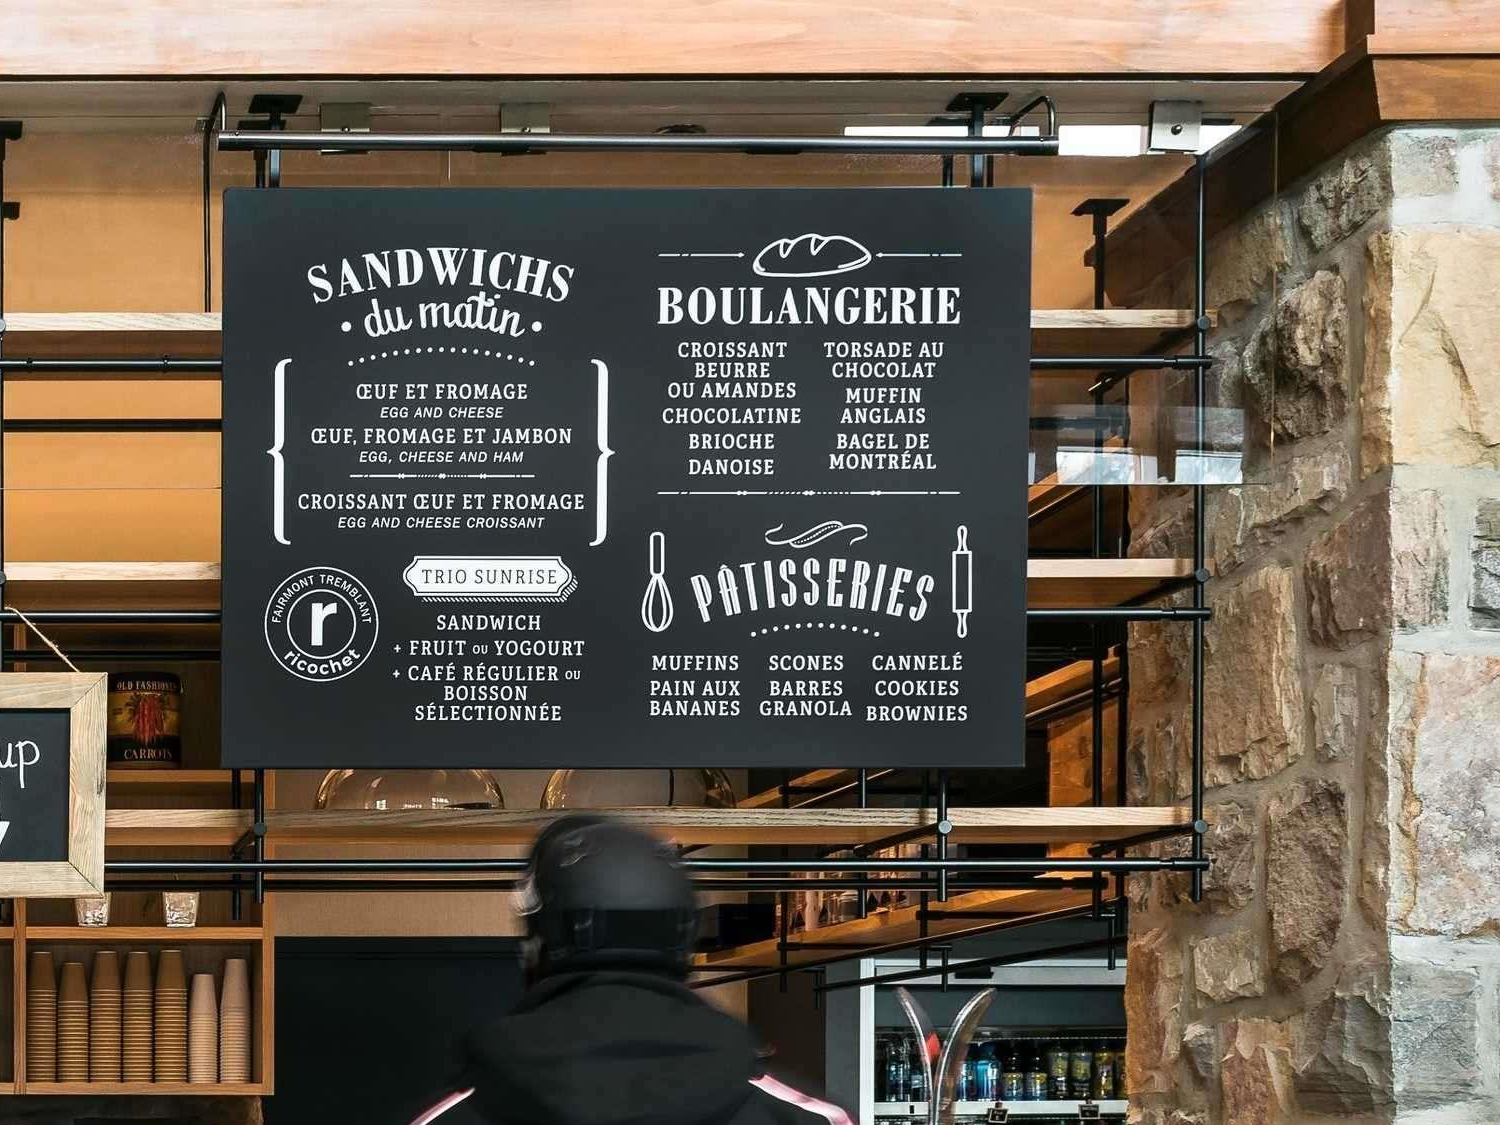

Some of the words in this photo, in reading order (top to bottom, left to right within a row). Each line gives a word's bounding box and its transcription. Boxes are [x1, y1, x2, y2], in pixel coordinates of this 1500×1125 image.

[307, 247, 574, 303] SANDWICHS
[657, 287, 960, 324] BOULANGERIE
[364, 299, 412, 337] du
[419, 291, 525, 337] matin
[678, 342, 787, 357] CROISSANT
[824, 342, 912, 357] TORSADE
[919, 342, 944, 357] AU
[695, 362, 770, 378] BEURRE
[832, 362, 936, 378] CHOCOLAT
[356, 384, 398, 399] ŒUF
[406, 384, 428, 399] ET
[436, 384, 527, 399] FROMAGE
[668, 382, 695, 398] OU
[701, 382, 796, 398] AMANDES
[846, 388, 921, 403] MUFFIN
[380, 407, 408, 418] EGG
[414, 407, 442, 418] AND
[449, 407, 503, 418] CHEESE
[663, 408, 801, 424] CHOCOLATINE
[840, 408, 925, 424] ANGLAIS
[311, 428, 356, 445] ŒUF,
[364, 428, 456, 444] FROMAGE
[463, 428, 486, 443] ET
[493, 428, 571, 444] JAMBON
[689, 434, 774, 449] BRIOCHE
[837, 433, 898, 449] BAGEL
[905, 434, 929, 449] DE
[360, 451, 391, 464] EGG,
[399, 451, 454, 462] CHEESE
[459, 452, 487, 462] AND
[494, 452, 523, 462] HAM
[829, 450, 936, 469] MONTRÉAL
[689, 459, 774, 475] DANOISE
[298, 494, 407, 509] CROISSANT
[414, 494, 455, 509] ŒUF
[463, 494, 485, 509] ET
[492, 494, 584, 509] FROMAGE
[338, 517, 366, 528] EGG
[372, 517, 400, 528] AND
[406, 517, 461, 528] CHEESE
[467, 517, 545, 528] CROISSANT
[422, 570, 466, 583] TRIO
[475, 570, 556, 584] SUNRISE
[691, 558, 934, 622] PÂTISSERIES
[272, 575, 314, 623] FAIRMONT
[319, 574, 372, 624] TREMBLANT
[311, 602, 337, 646] r
[437, 615, 540, 630] SANDWICH
[410, 641, 466, 655] FRUIT
[494, 640, 584, 655] YOGOURT
[284, 648, 360, 675] ricochet
[652, 655, 738, 670] MUFFINS
[769, 655, 843, 670] SCONES
[872, 652, 962, 670] CANNELÉ
[408, 662, 455, 680] CAFÉ
[463, 663, 558, 681] RÉGULIER
[117, 681, 133, 690] OLD
[650, 681, 695, 696] PAIN
[702, 681, 740, 696] AUX
[770, 681, 842, 696] BARRES
[875, 680, 958, 696] COOKIES
[444, 686, 527, 701] BOISSON
[415, 702, 561, 720] SÉLECTIONNÉE
[650, 701, 740, 715] BANANES
[760, 701, 852, 716] GRANOLA
[867, 706, 967, 721] BROWNIES
